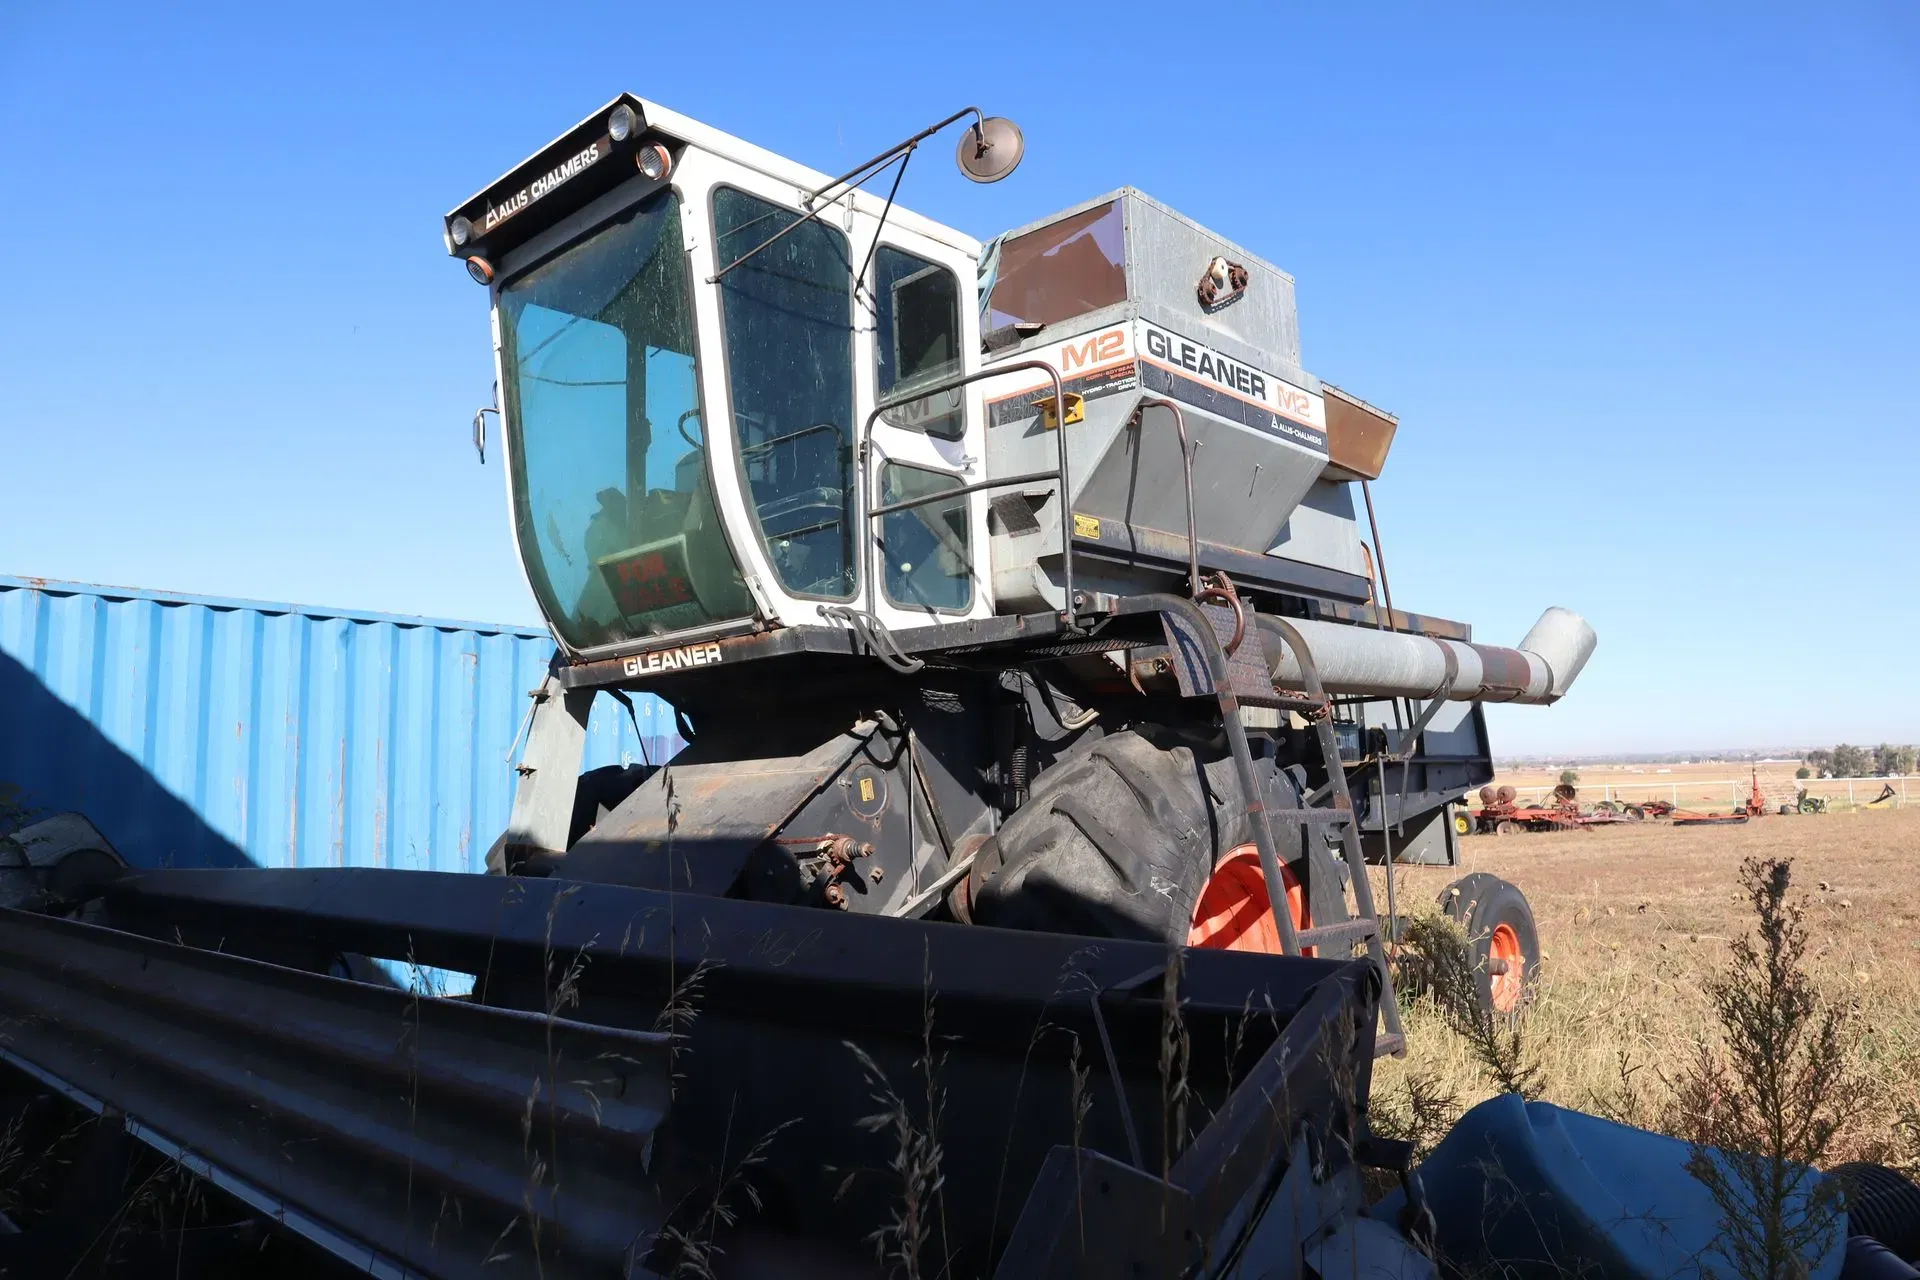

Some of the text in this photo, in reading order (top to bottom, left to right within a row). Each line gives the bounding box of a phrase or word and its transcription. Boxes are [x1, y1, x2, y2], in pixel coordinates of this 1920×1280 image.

[499, 143, 599, 220] ALLIS CHALMERS
[1062, 330, 1125, 371] M2
[1146, 329, 1310, 417] GLEANER M2
[617, 552, 667, 585] FOR
[623, 643, 723, 677] GLEANER
